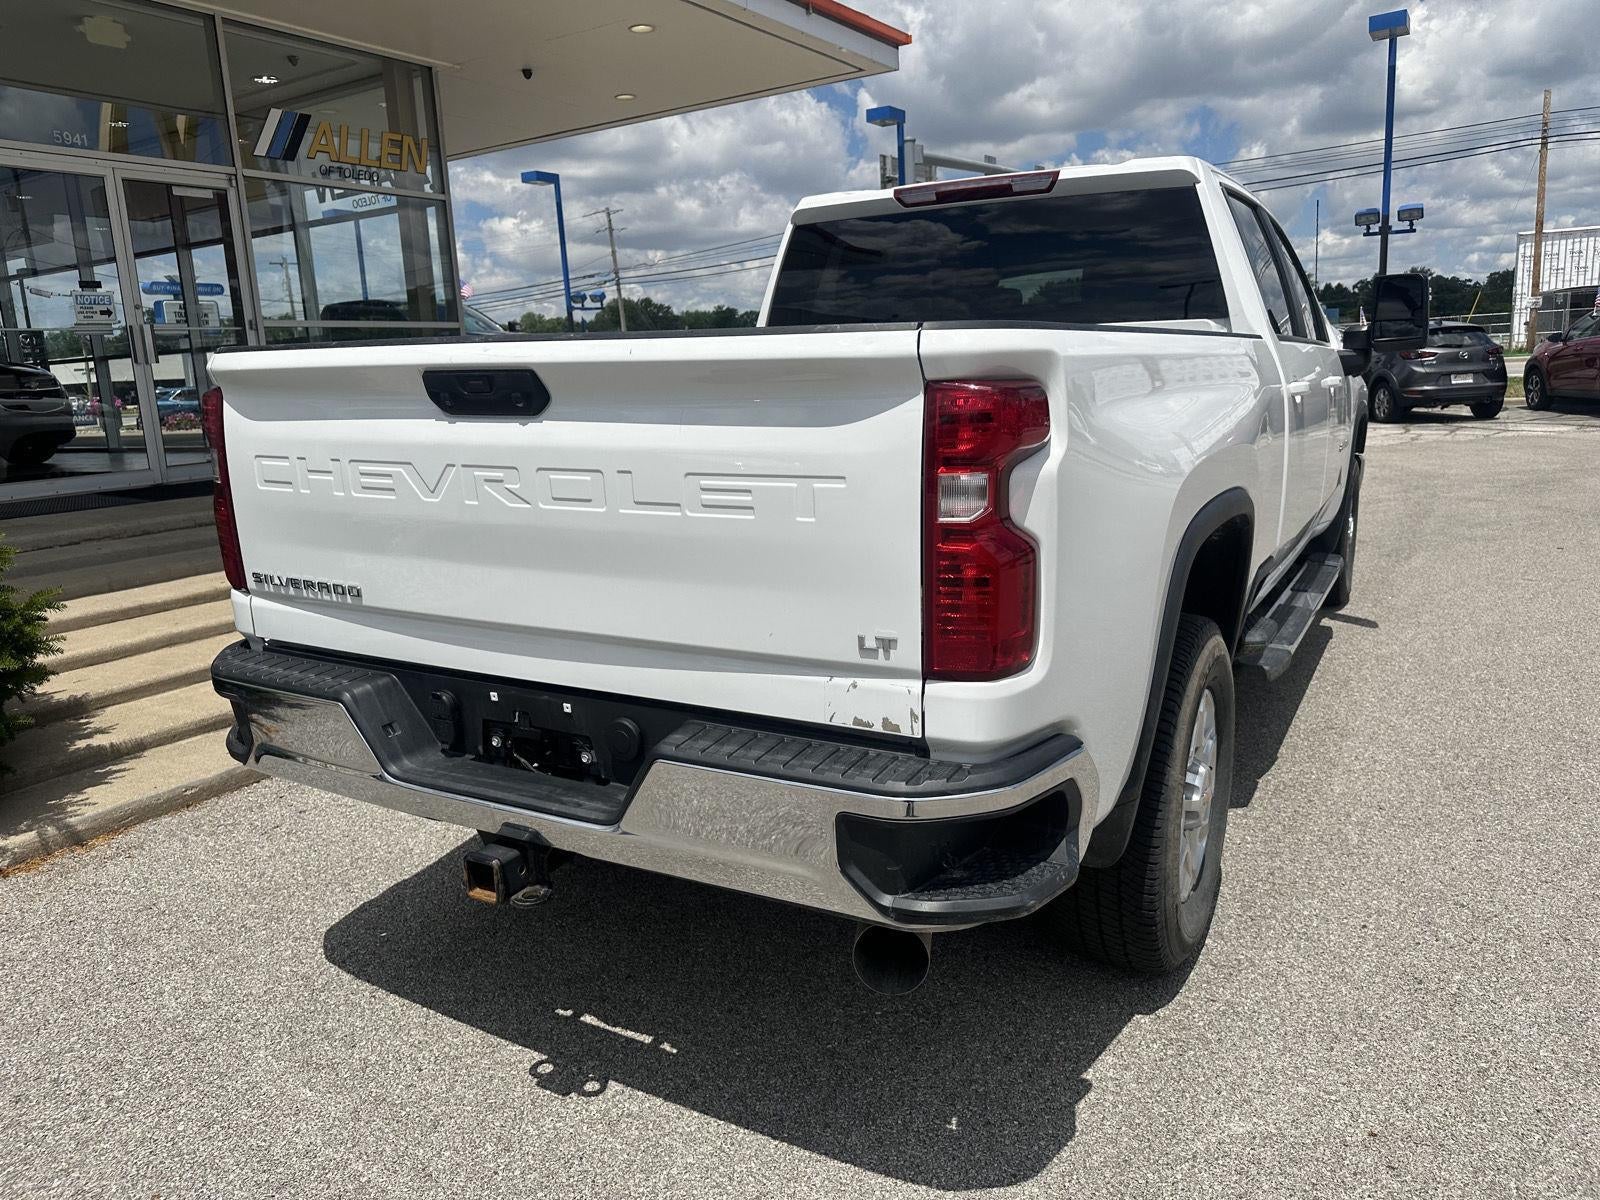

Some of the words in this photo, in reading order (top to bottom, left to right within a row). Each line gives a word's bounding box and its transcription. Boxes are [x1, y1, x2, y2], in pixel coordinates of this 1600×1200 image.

[53, 130, 88, 147] 5941
[307, 121, 428, 175] ALLEN
[319, 164, 335, 177] OF
[336, 166, 380, 182] TOLEDO
[77, 295, 110, 305] NOTICE
[254, 454, 847, 522] CHEVROLET
[251, 572, 362, 598] SILVERADO
[857, 632, 898, 661] LT
